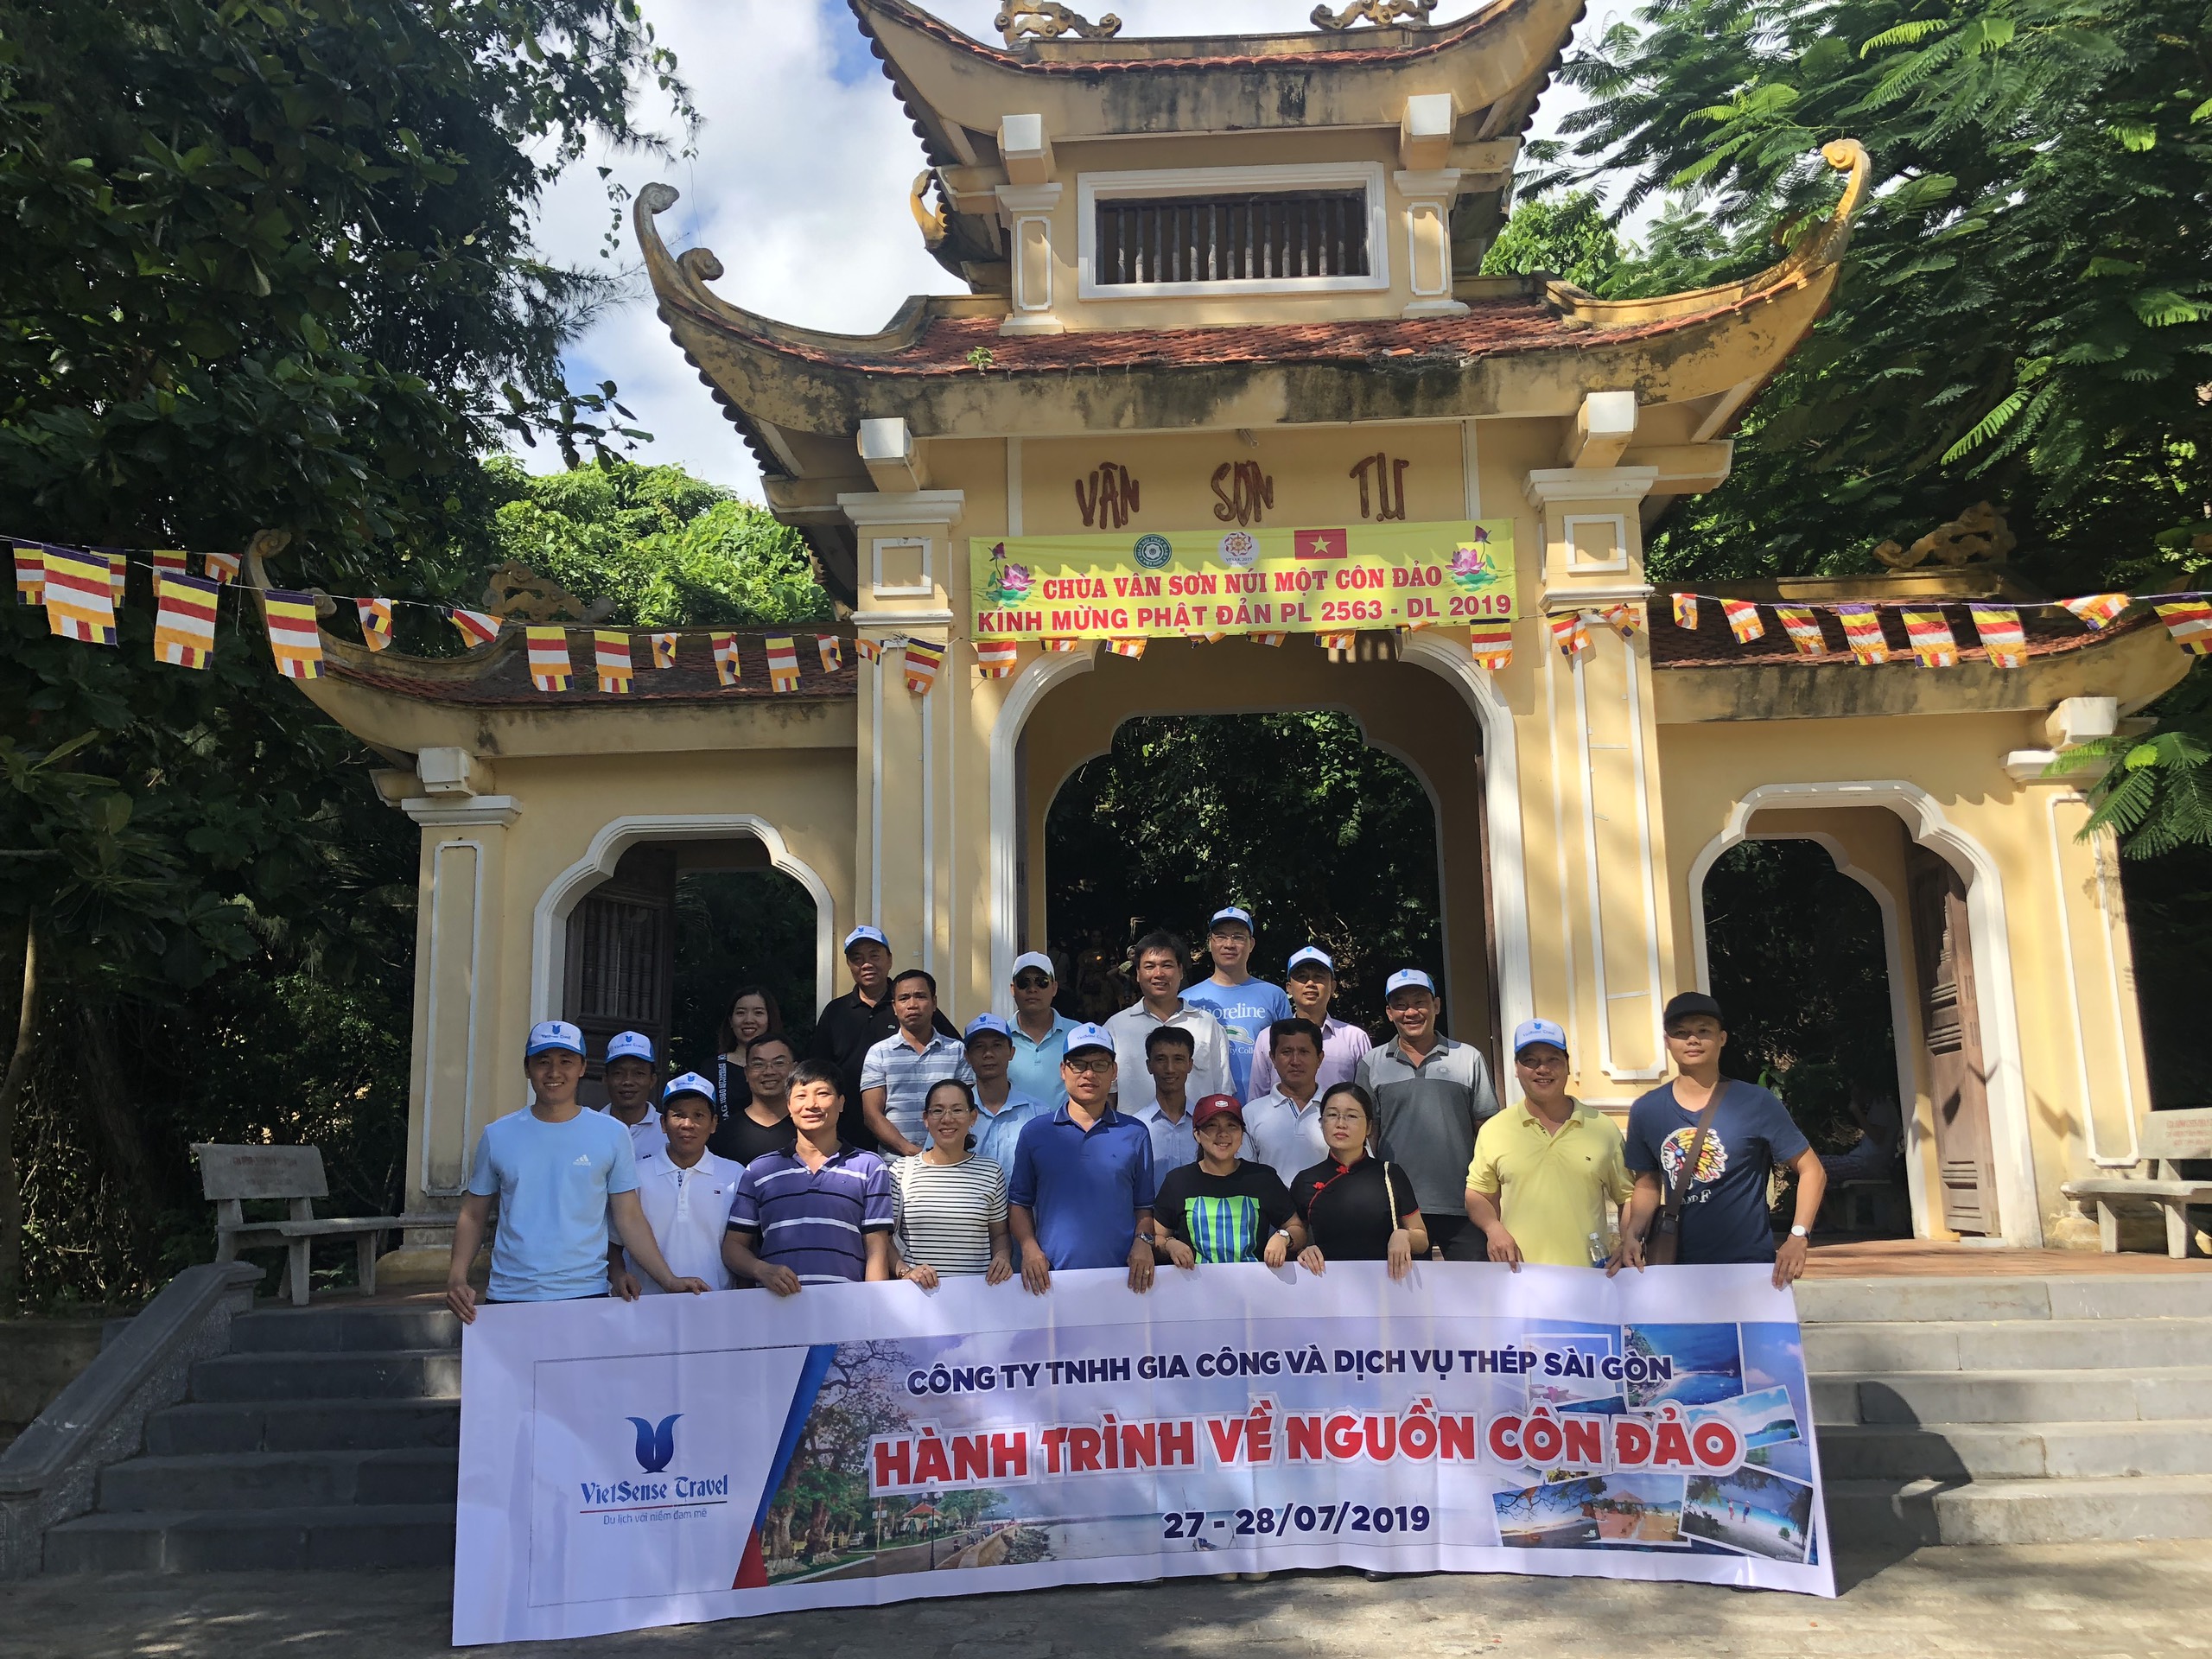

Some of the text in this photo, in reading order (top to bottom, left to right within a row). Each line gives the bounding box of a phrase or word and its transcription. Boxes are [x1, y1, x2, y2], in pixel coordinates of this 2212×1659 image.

[1076, 461, 1140, 530] VÂN
[1043, 560, 1442, 600] CHÙA VÂN SƠN NÚI MỘT CÔN ĐẢO
[978, 606, 1042, 632] KÍNH
[1052, 604, 1128, 631] MỪNG
[1137, 601, 1208, 632] PHẬT
[1215, 597, 1272, 626] ĐẢN
[1281, 602, 1313, 623] PL
[1321, 600, 1382, 621] 2563
[1407, 597, 1440, 618] DL
[1449, 594, 1511, 616] 2019
[908, 1343, 1672, 1395] CÔNG TY TNHH GIA CÔNG VÀ DỊCH VỤ THÉP SÀI GÒN
[873, 1397, 1737, 1487] HÀNH TRÌNH VỀ NGUỒN CÔN ĐẢO
[581, 1473, 728, 1504] VietSense Travel
[603, 1515, 616, 1525] Du
[618, 1513, 632, 1526] lịch
[673, 1509, 692, 1520] đam
[693, 1508, 708, 1518] mê
[1164, 1501, 1430, 1539] 27 - 28/07/2019
